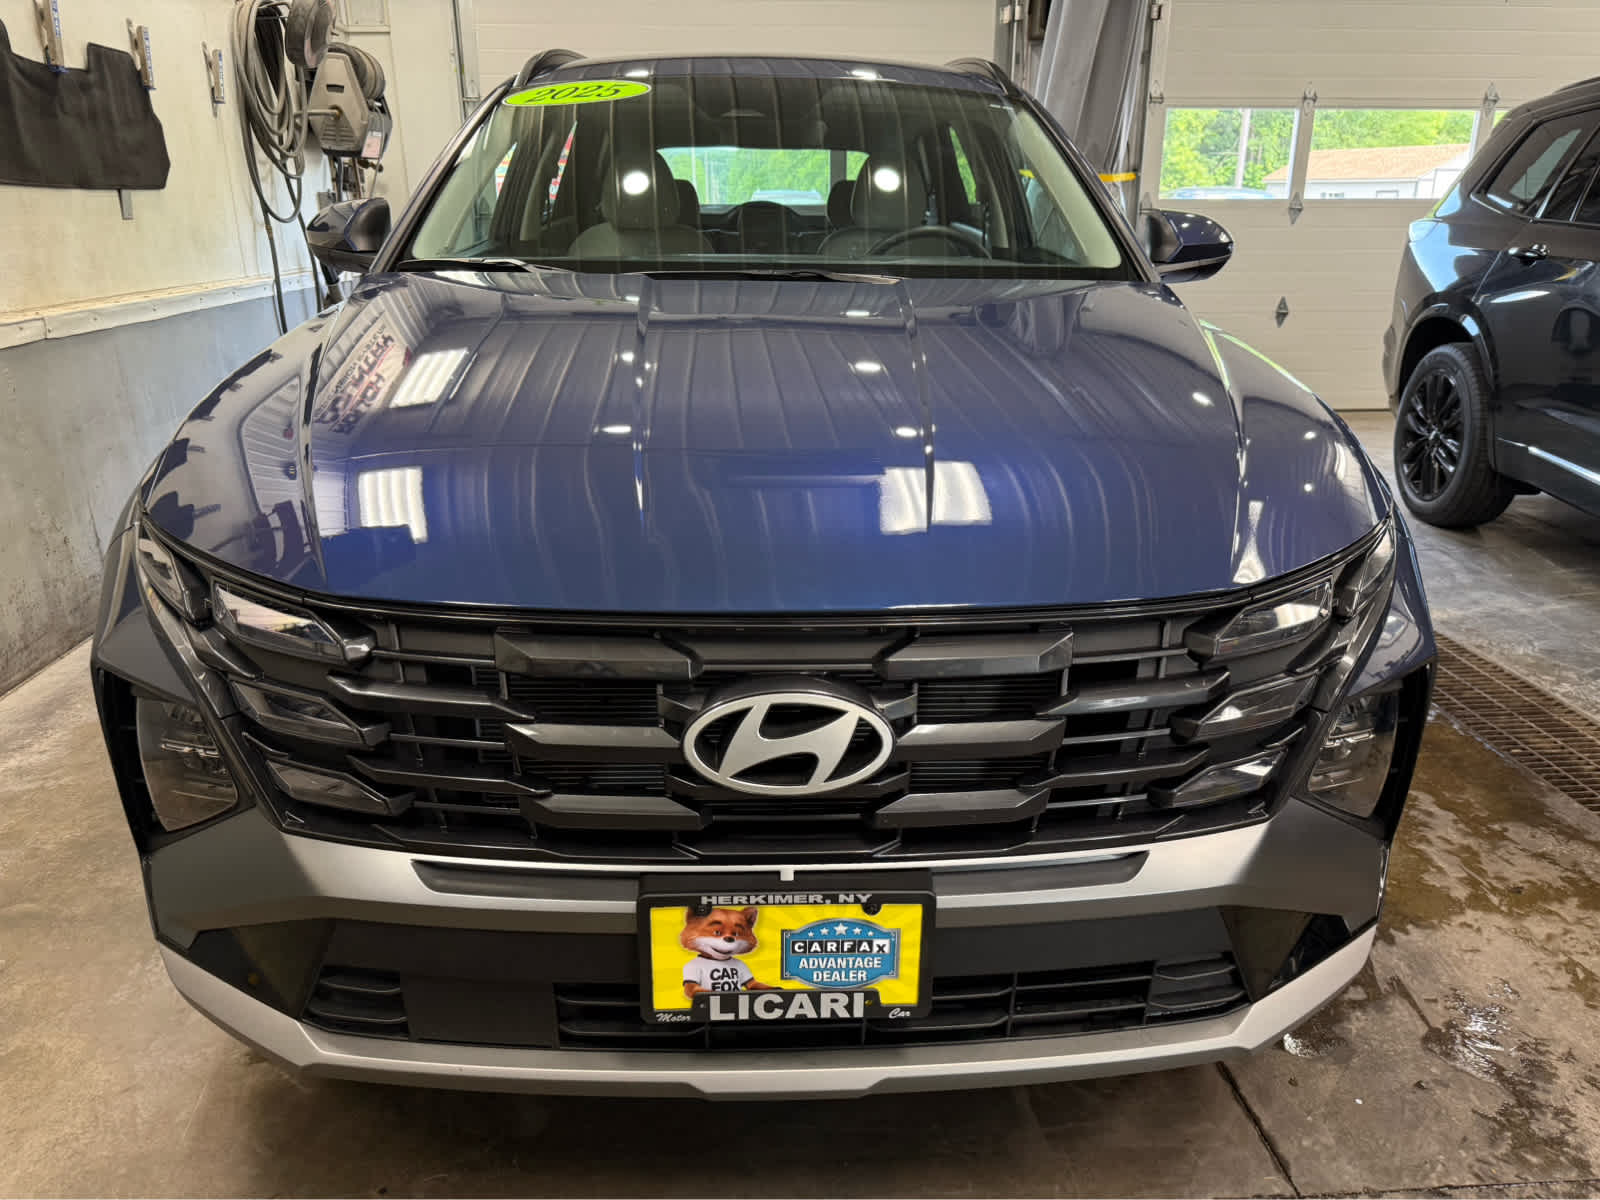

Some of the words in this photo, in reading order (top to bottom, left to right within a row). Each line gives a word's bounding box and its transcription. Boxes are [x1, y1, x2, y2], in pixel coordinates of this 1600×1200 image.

[524, 84, 629, 103] 2025
[701, 893, 832, 906] HERKIMER,
[837, 893, 873, 904] NY
[793, 940, 890, 954] CARFAX
[798, 956, 882, 969] ADVANTAGE
[709, 967, 739, 981] CAR
[812, 969, 868, 983] DEALER
[711, 980, 741, 992] FOX
[709, 992, 865, 1022] LICARI
[888, 1007, 912, 1020] Car
[655, 1012, 692, 1024] Motor
